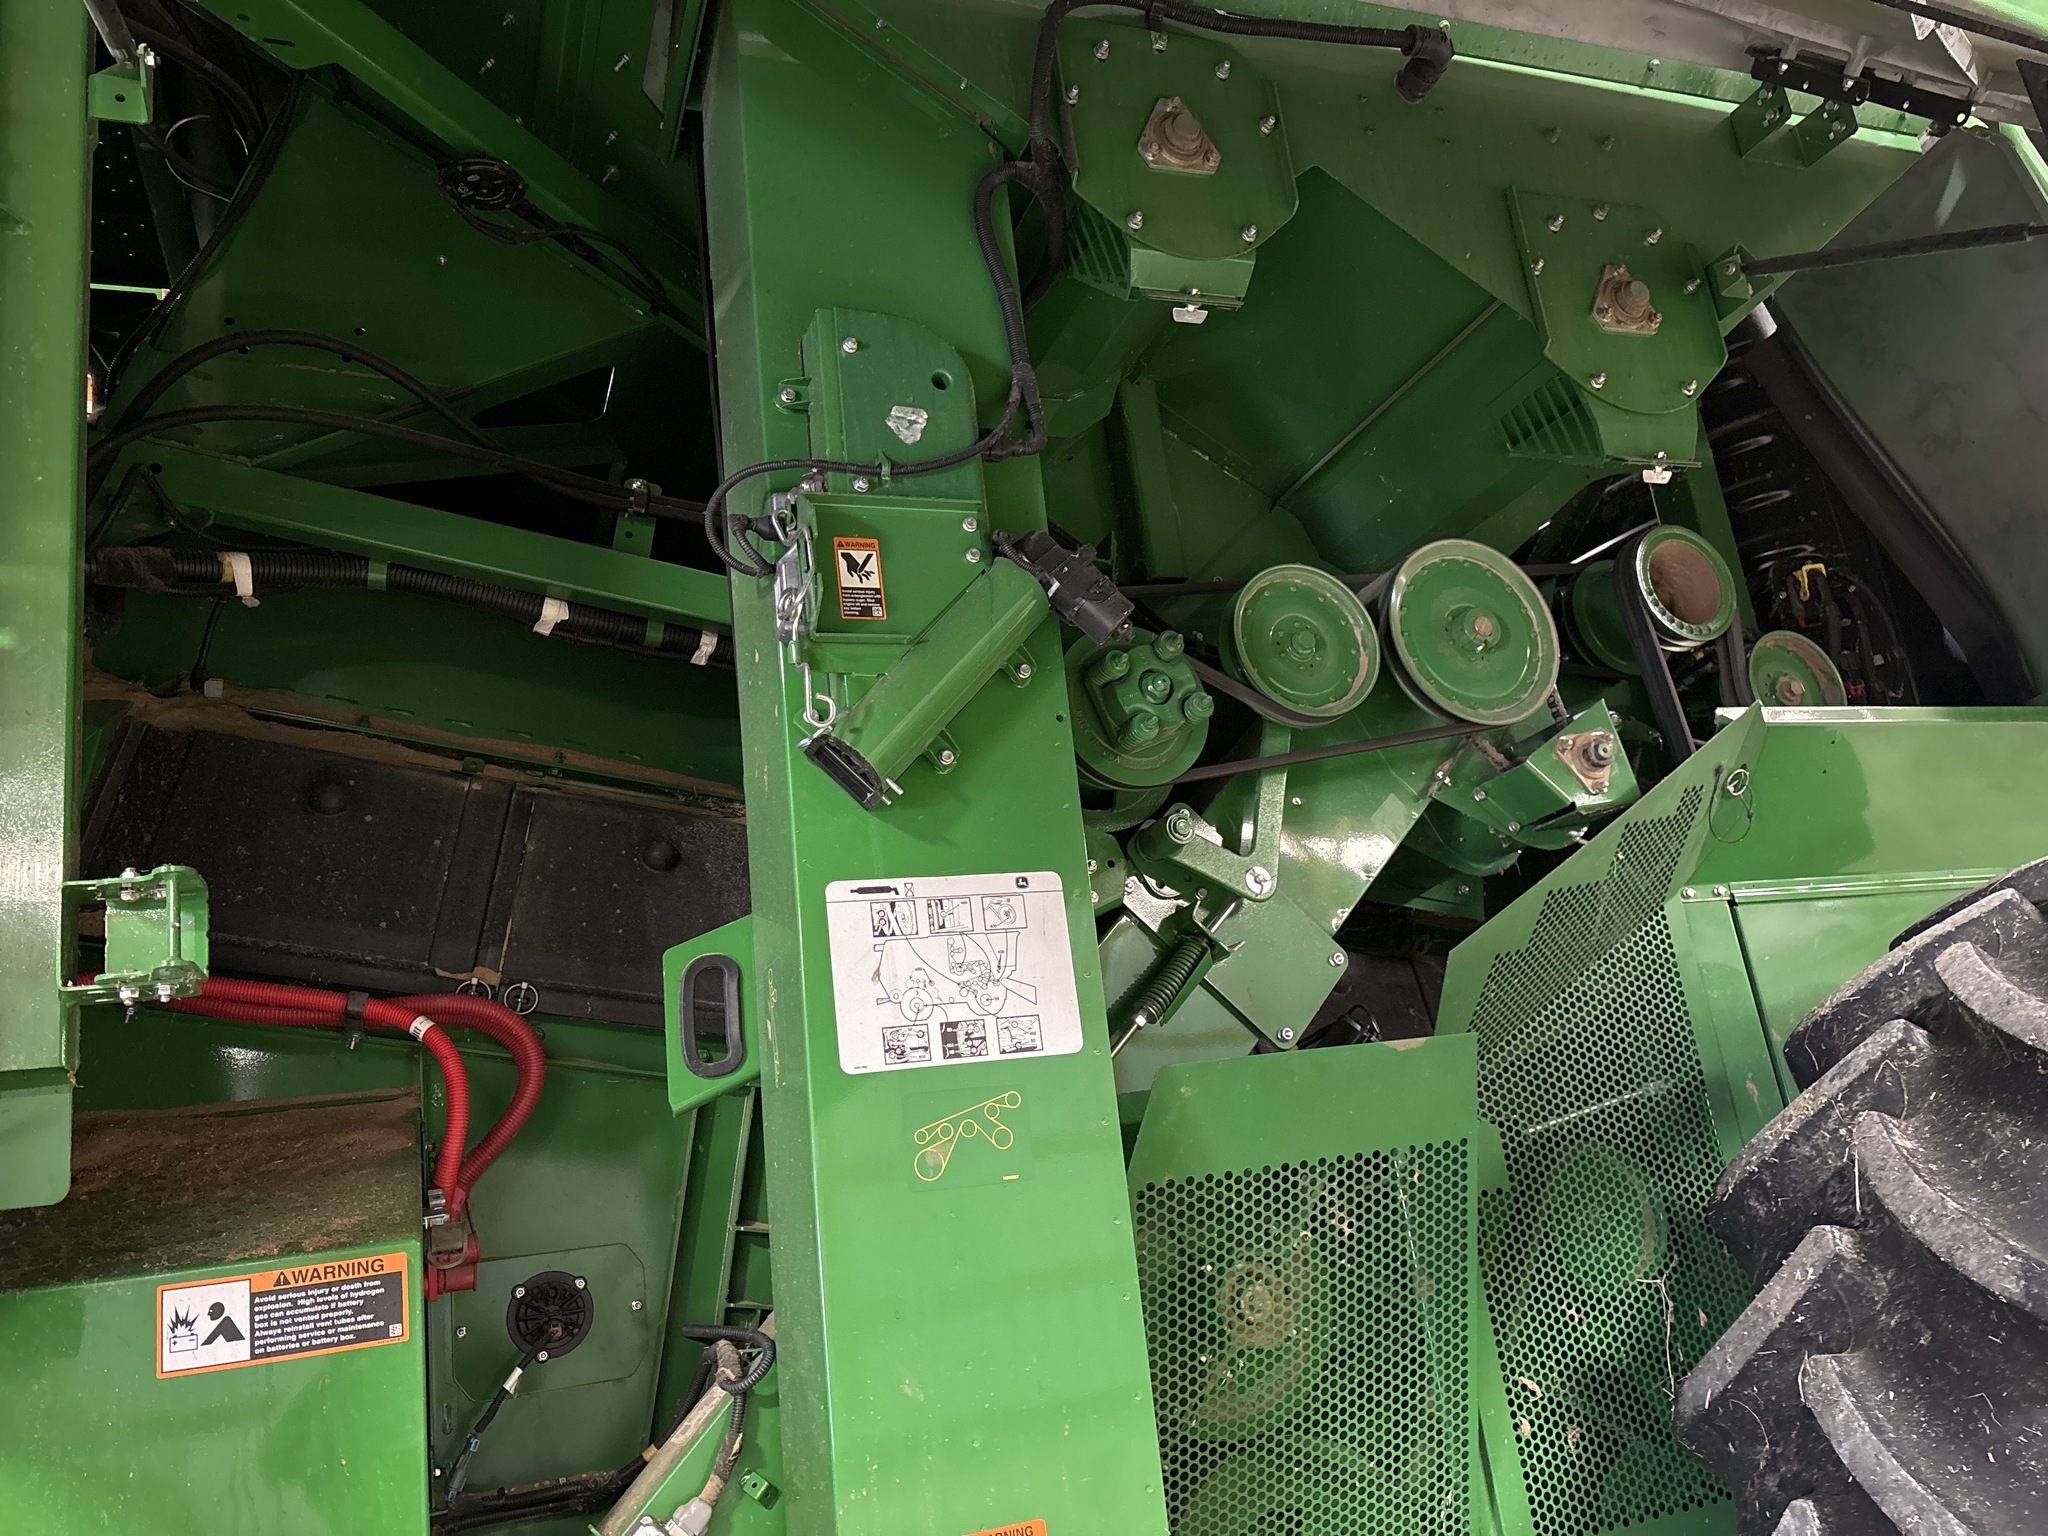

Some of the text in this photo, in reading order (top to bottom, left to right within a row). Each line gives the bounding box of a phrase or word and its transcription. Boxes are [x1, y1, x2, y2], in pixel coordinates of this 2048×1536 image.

[292, 1258, 384, 1284] WARNING
[254, 1295, 277, 1304] Avoid
[278, 1292, 306, 1301] serious
[308, 1288, 329, 1297] injury
[341, 1283, 362, 1291] death
[254, 1301, 294, 1313] explosion.
[297, 1298, 315, 1306] High
[317, 1295, 339, 1303] levels
[350, 1287, 385, 1297] hydrogen
[286, 1305, 329, 1316] accumulate
[338, 1299, 364, 1308] battery
[254, 1321, 269, 1329] box
[270, 1319, 278, 1327] is
[294, 1313, 319, 1323] vented
[321, 1309, 354, 1320] properly.
[255, 1328, 282, 1337] Always
[284, 1323, 314, 1332] reinstall
[334, 1317, 355, 1325] tubes
[357, 1314, 375, 1322] after
[255, 1334, 297, 1347] performing
[298, 1331, 326, 1339] service
[338, 1321, 385, 1333] maintenance
[267, 1342, 300, 1352] batteries
[312, 1336, 338, 1345] battery
